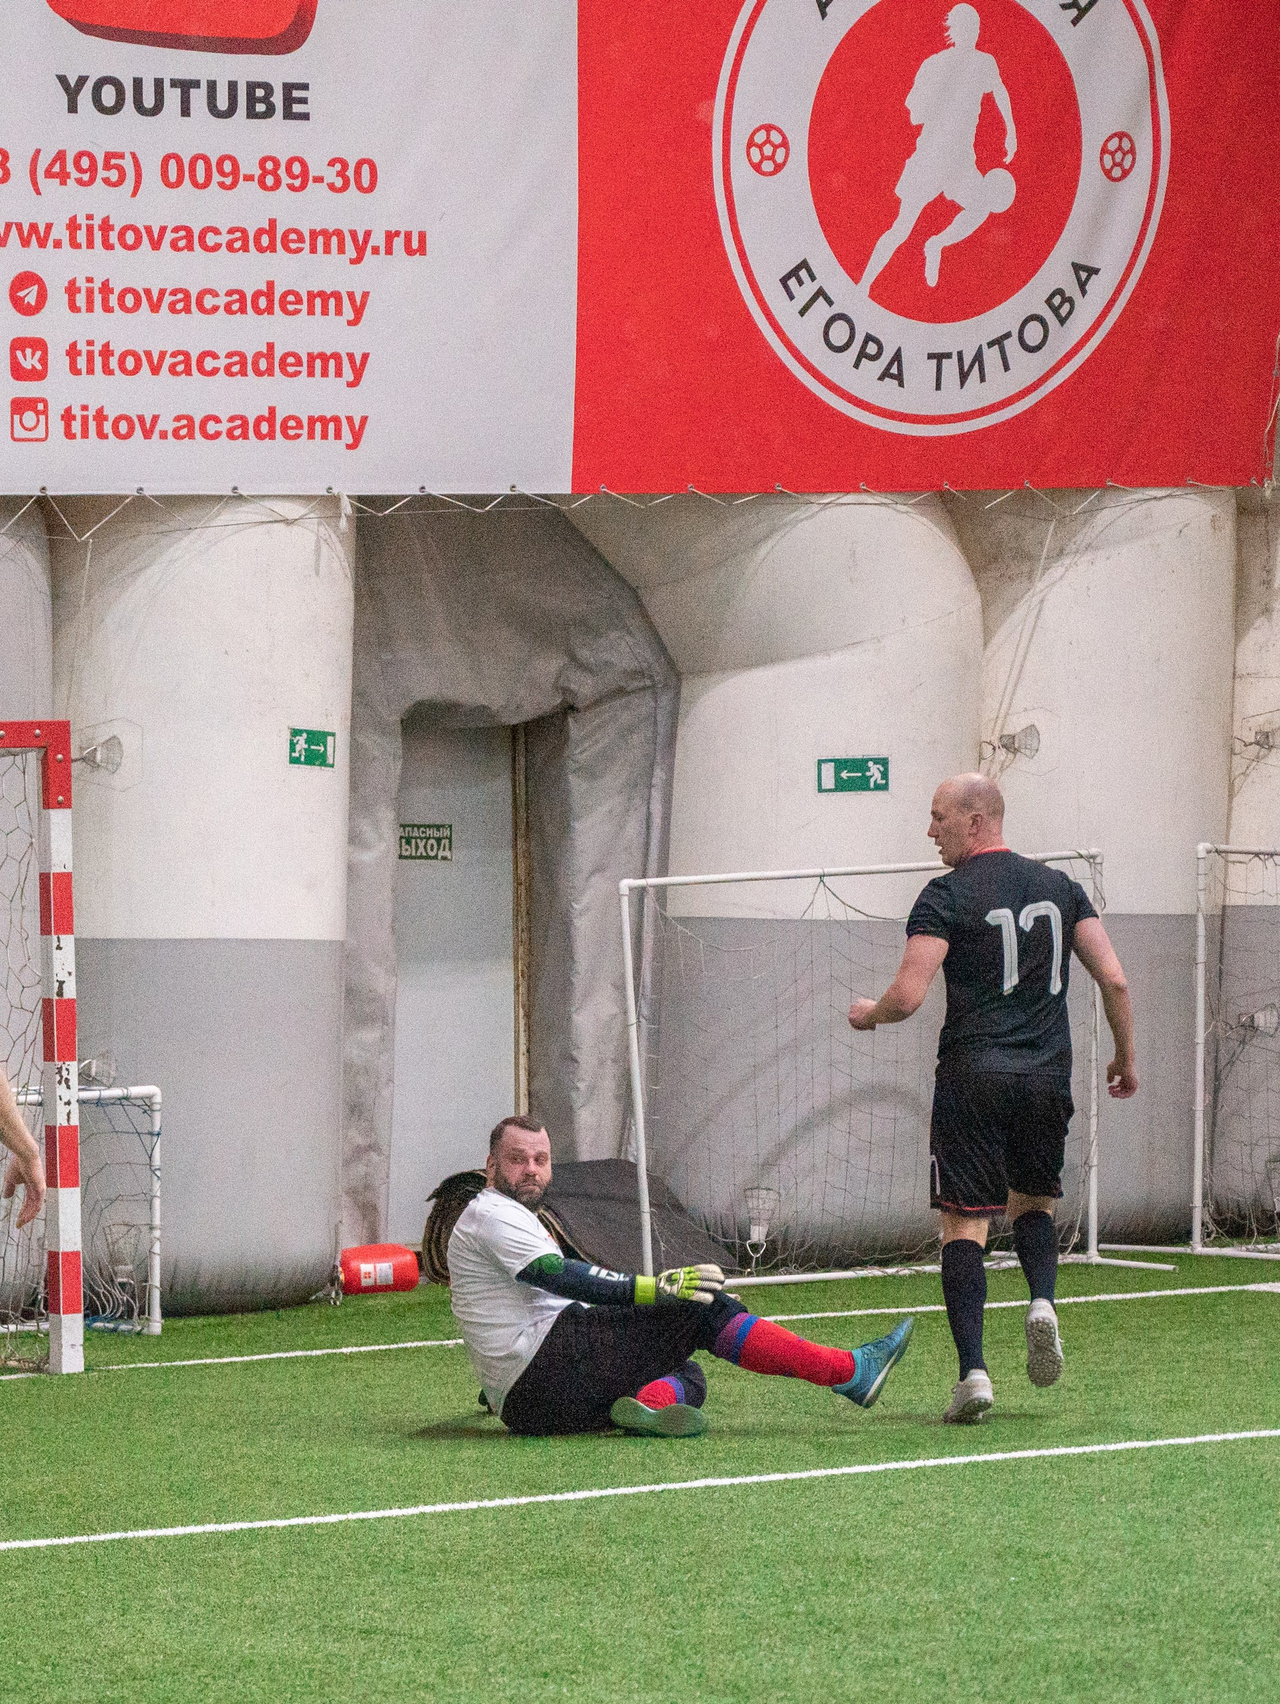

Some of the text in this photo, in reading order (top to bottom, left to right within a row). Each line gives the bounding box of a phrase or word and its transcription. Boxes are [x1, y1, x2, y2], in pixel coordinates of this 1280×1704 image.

[56, 74, 311, 121] YOUTUBE
[28, 148, 144, 198] (495)
[159, 152, 380, 195] 009-89-30
[64, 276, 371, 327] titovacademy
[779, 258, 1102, 391] ЕГОРА ТИТОВА
[64, 339, 371, 389] titovacademy
[60, 404, 369, 451] titov.academy
[399, 825, 451, 838] АПАСНЫЙ
[400, 838, 452, 860] ЫХОД
[984, 900, 1063, 997] 17
